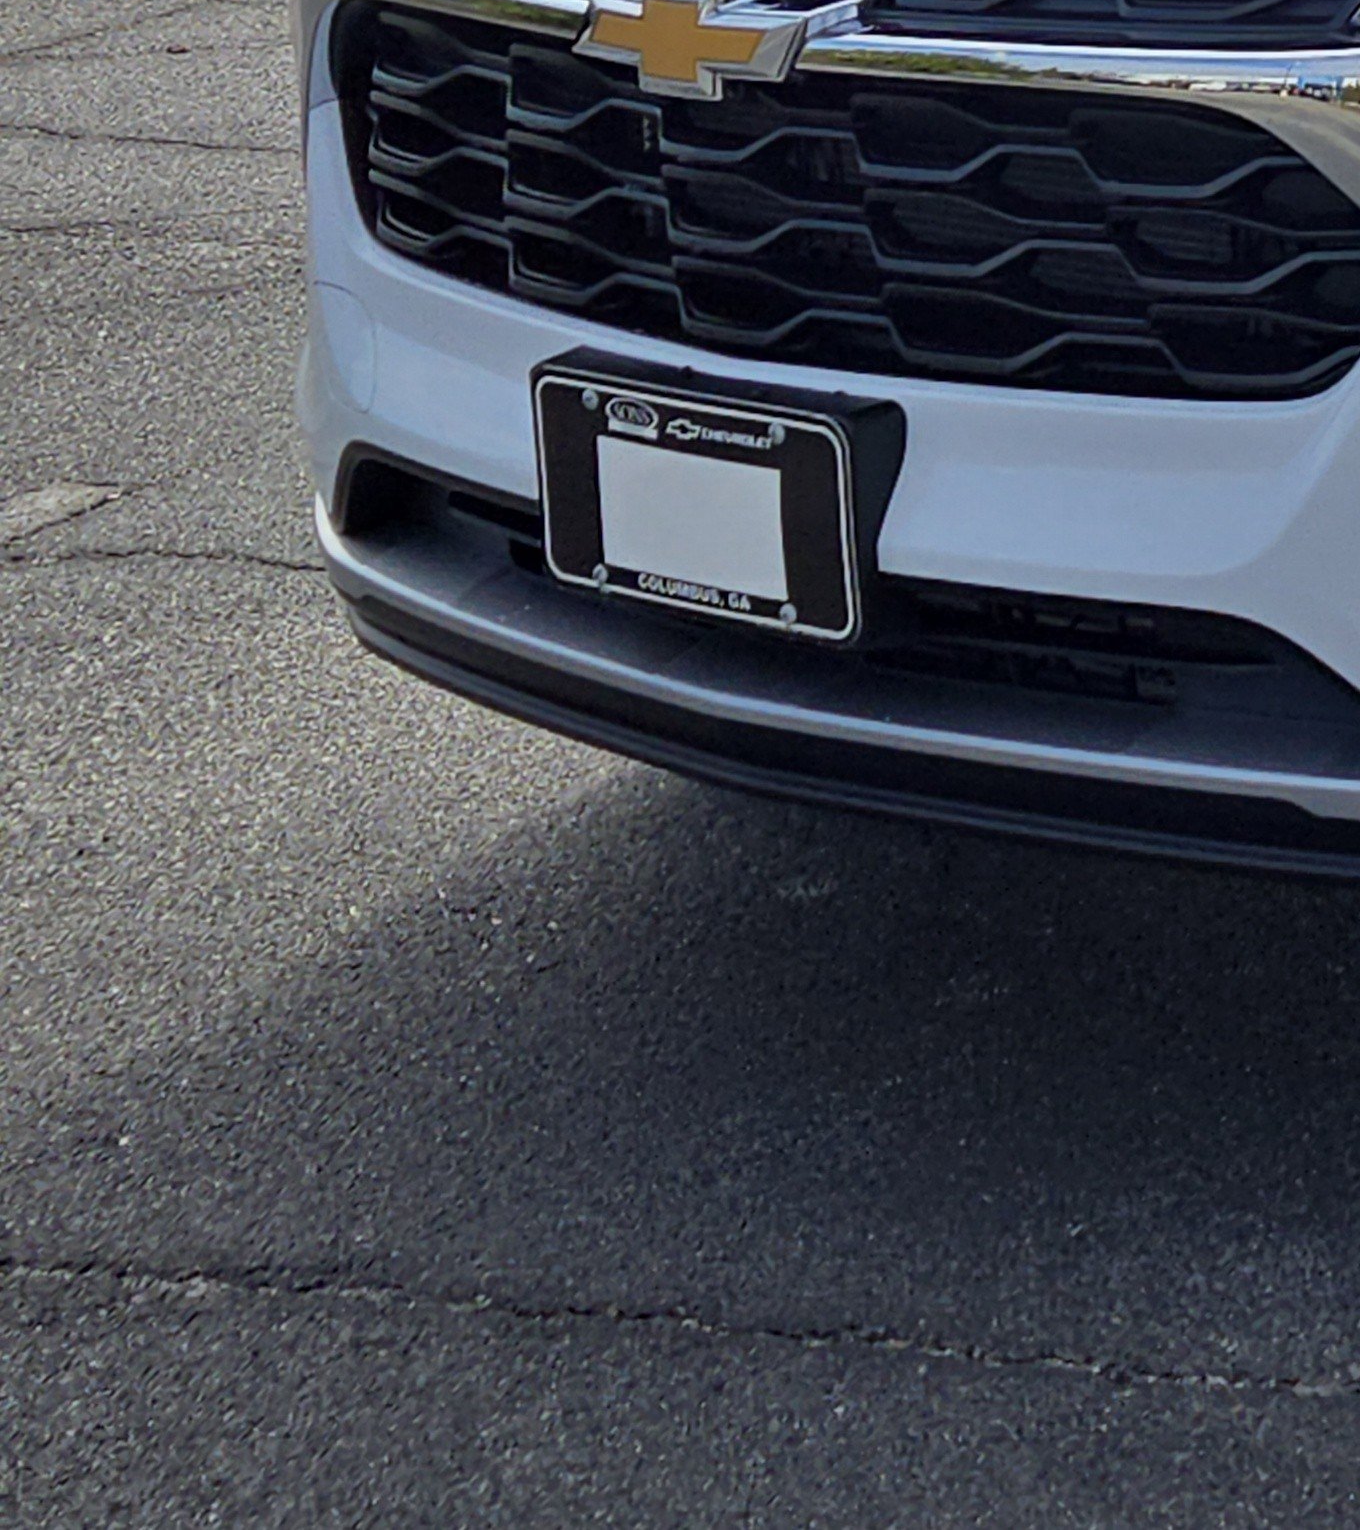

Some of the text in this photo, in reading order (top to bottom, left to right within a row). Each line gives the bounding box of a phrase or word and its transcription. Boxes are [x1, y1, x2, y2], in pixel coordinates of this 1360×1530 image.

[700, 426, 773, 450] CHEVROLET
[638, 572, 751, 611] COLUMBUS, GA
